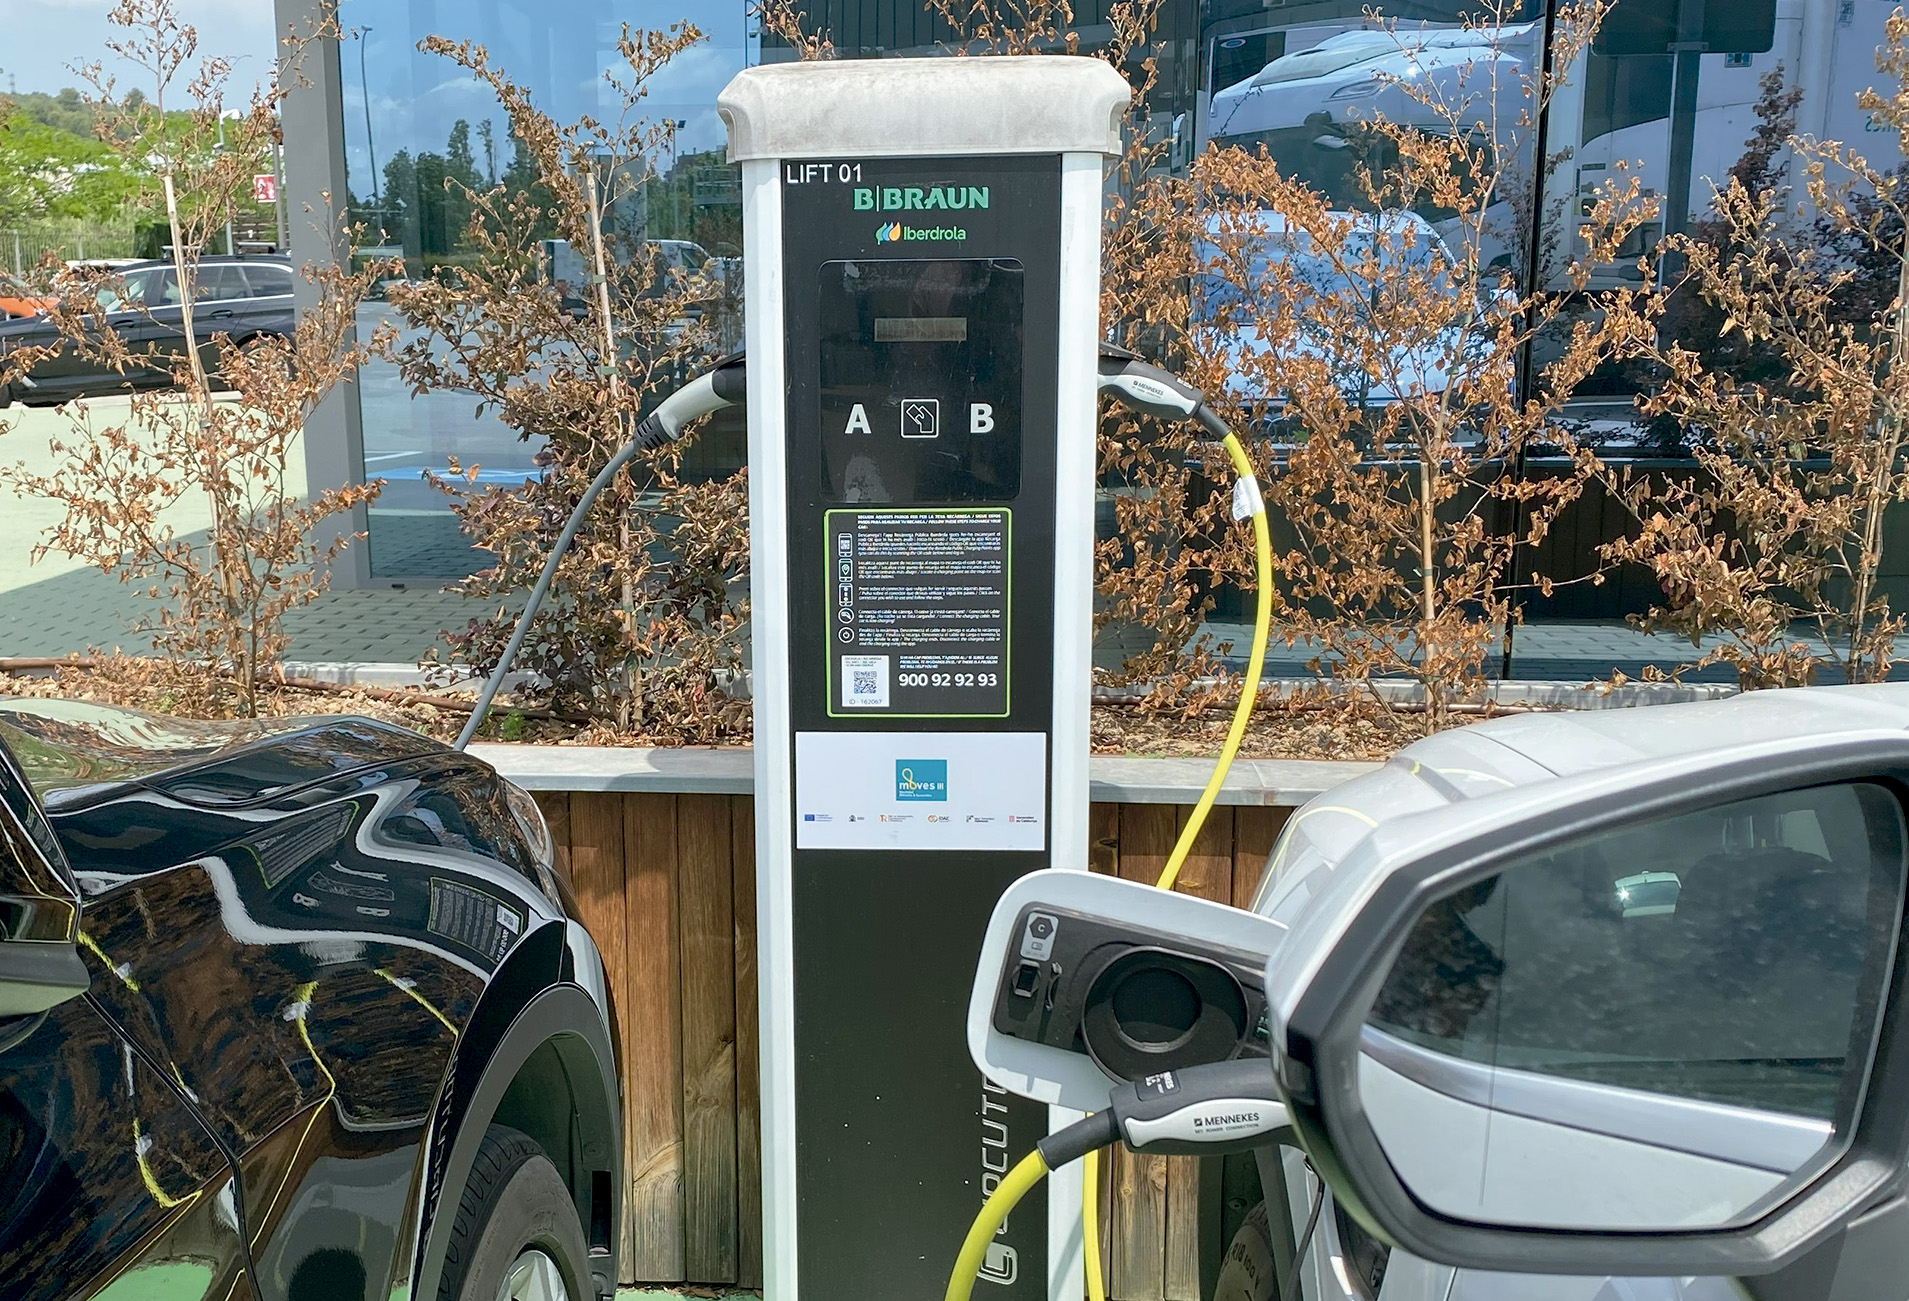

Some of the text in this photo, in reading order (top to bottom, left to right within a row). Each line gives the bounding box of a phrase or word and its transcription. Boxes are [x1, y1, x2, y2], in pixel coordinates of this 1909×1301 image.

[786, 163, 861, 183] LIFT 01
[903, 225, 967, 241] Iberdrola
[844, 403, 872, 434] A
[970, 403, 994, 434] B
[898, 673, 997, 686] 900 92 92 93
[899, 782, 936, 790] moves
[1038, 923, 1045, 932] C
[1205, 1112, 1260, 1126] MENNEKES
